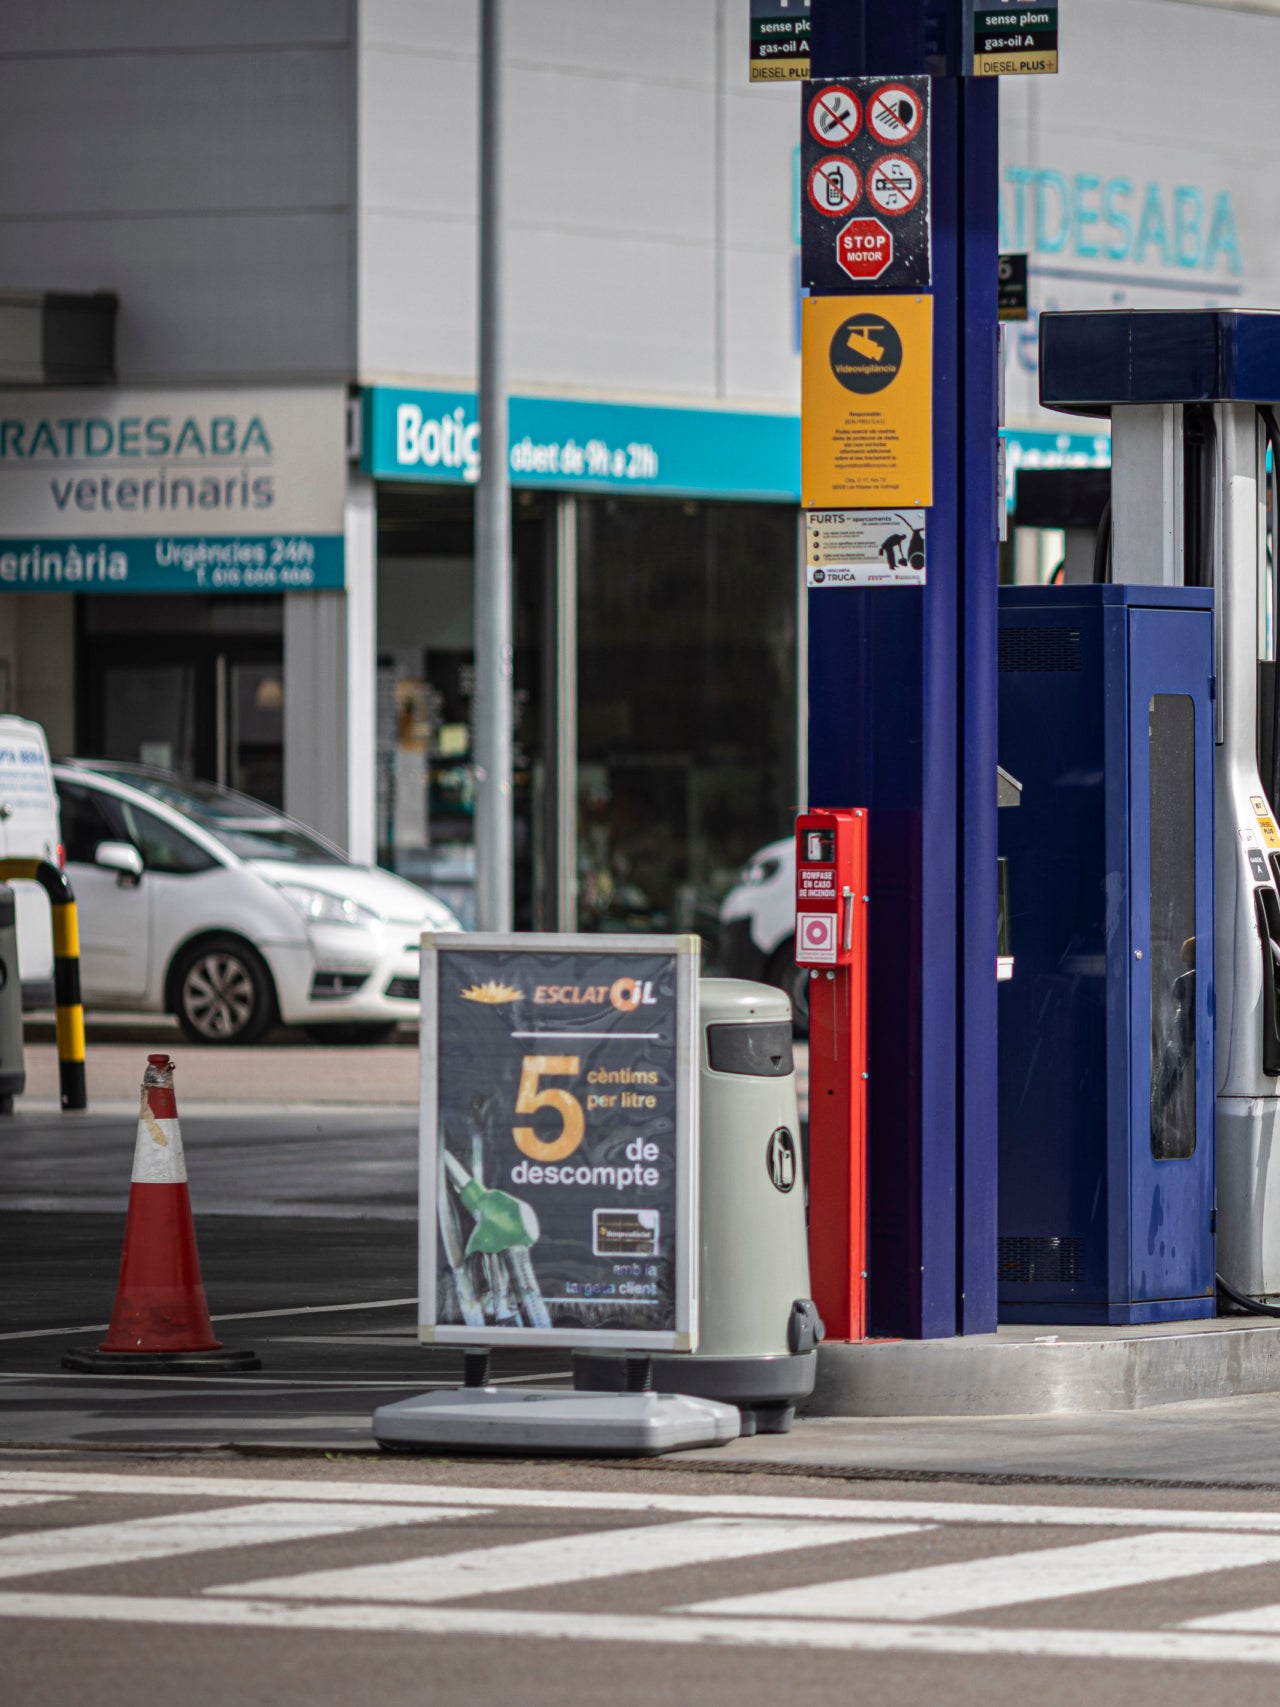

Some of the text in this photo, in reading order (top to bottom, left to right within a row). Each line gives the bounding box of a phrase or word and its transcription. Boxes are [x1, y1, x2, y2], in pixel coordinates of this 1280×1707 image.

[760, 19, 811, 34] sense plo
[985, 12, 1049, 27] sense plom
[759, 40, 810, 56] gas-oil A
[985, 35, 1034, 50] gas-oil A
[752, 67, 811, 78] DIESEL PLU
[984, 61, 1017, 73] DIESEL
[843, 236, 886, 249] STOP
[847, 252, 882, 261] MOTOR
[835, 364, 897, 374] Videovigilància
[0, 416, 272, 459] RATDESABA
[396, 403, 481, 483] Botig
[560, 439, 585, 475] de
[586, 439, 611, 476] 9h
[50, 467, 275, 511] veterinaris
[810, 513, 846, 524] FURTS
[852, 515, 892, 523] aparcaments
[0, 538, 315, 582] erinària Urgències 24h
[827, 574, 856, 582] TRUCA
[802, 871, 832, 880] ROMPASE
[803, 880, 831, 888] EN CASO
[799, 888, 836, 897] DE INCENDIO
[587, 1067, 658, 1085] cèntims
[511, 1055, 585, 1162] 5
[587, 1092, 656, 1110] per litre
[625, 1137, 659, 1161] de
[511, 1161, 660, 1191] descompte
[613, 1263, 657, 1276] amb la
[618, 1280, 657, 1295] client
